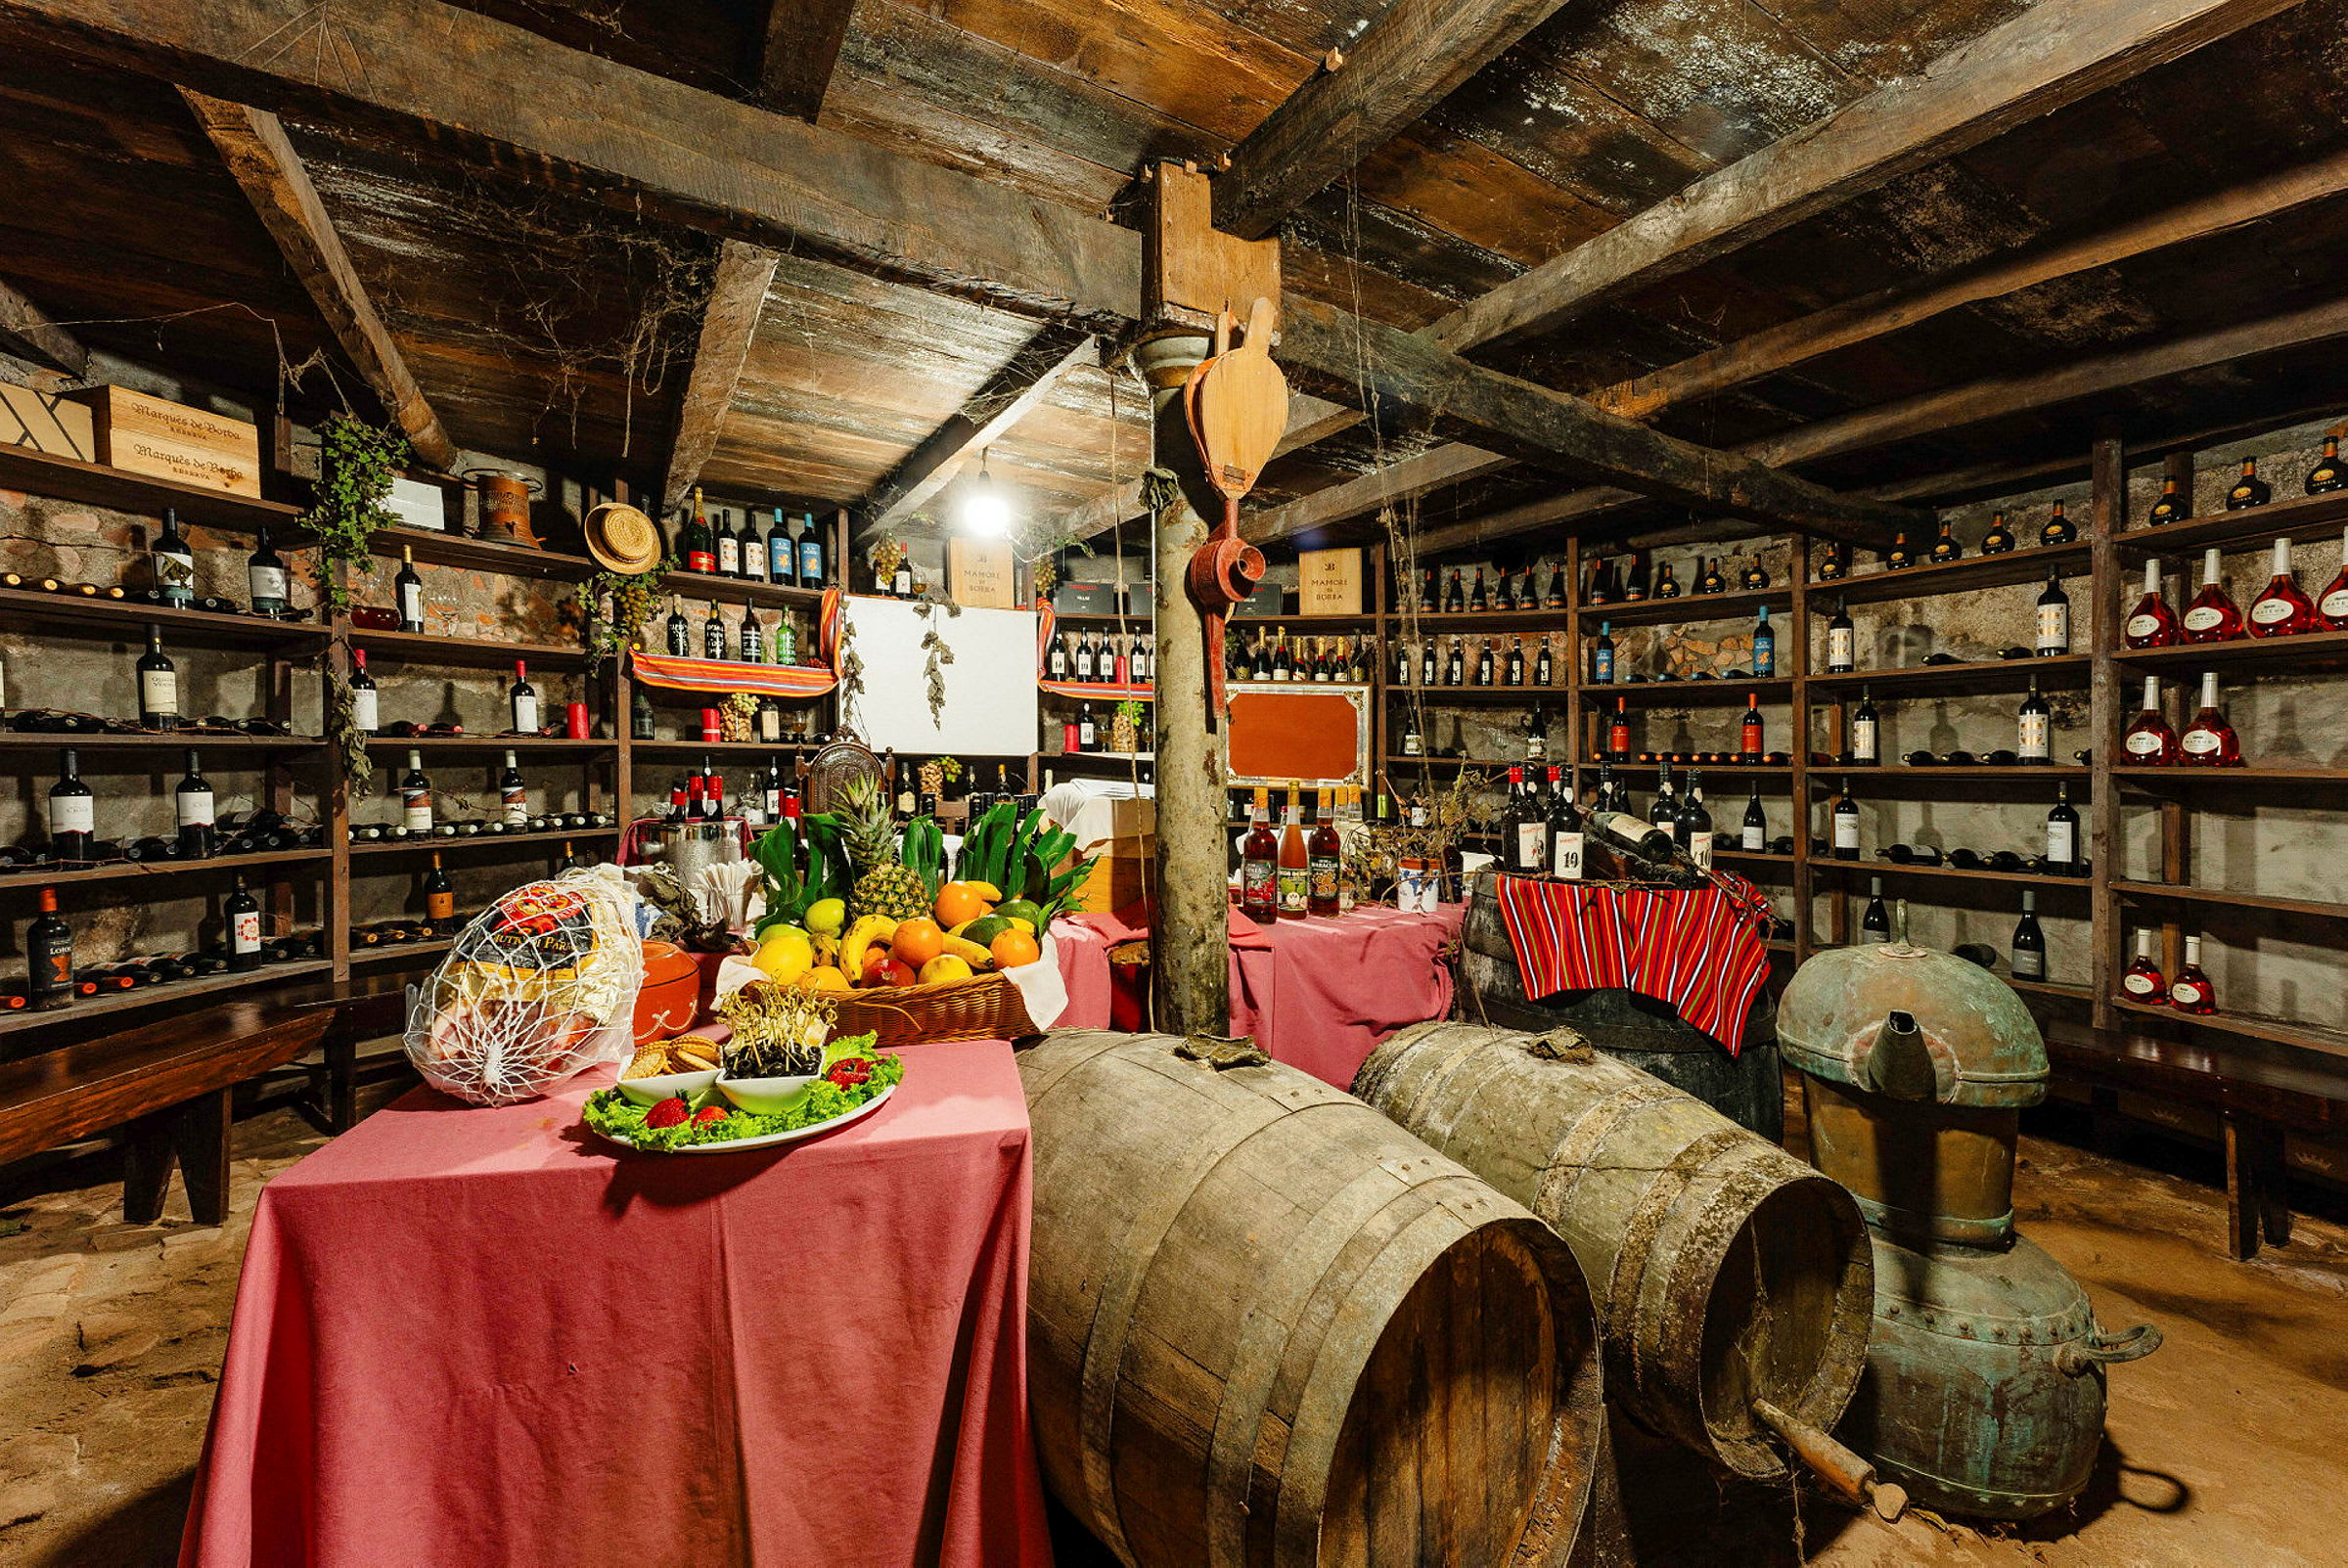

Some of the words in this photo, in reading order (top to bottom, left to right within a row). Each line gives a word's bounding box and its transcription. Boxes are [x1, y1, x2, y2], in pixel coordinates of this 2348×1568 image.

[190, 419, 203, 430] de
[204, 420, 241, 439] Borba
[135, 444, 191, 466] Marquês
[193, 458, 206, 470] de
[207, 461, 244, 480] Borba
